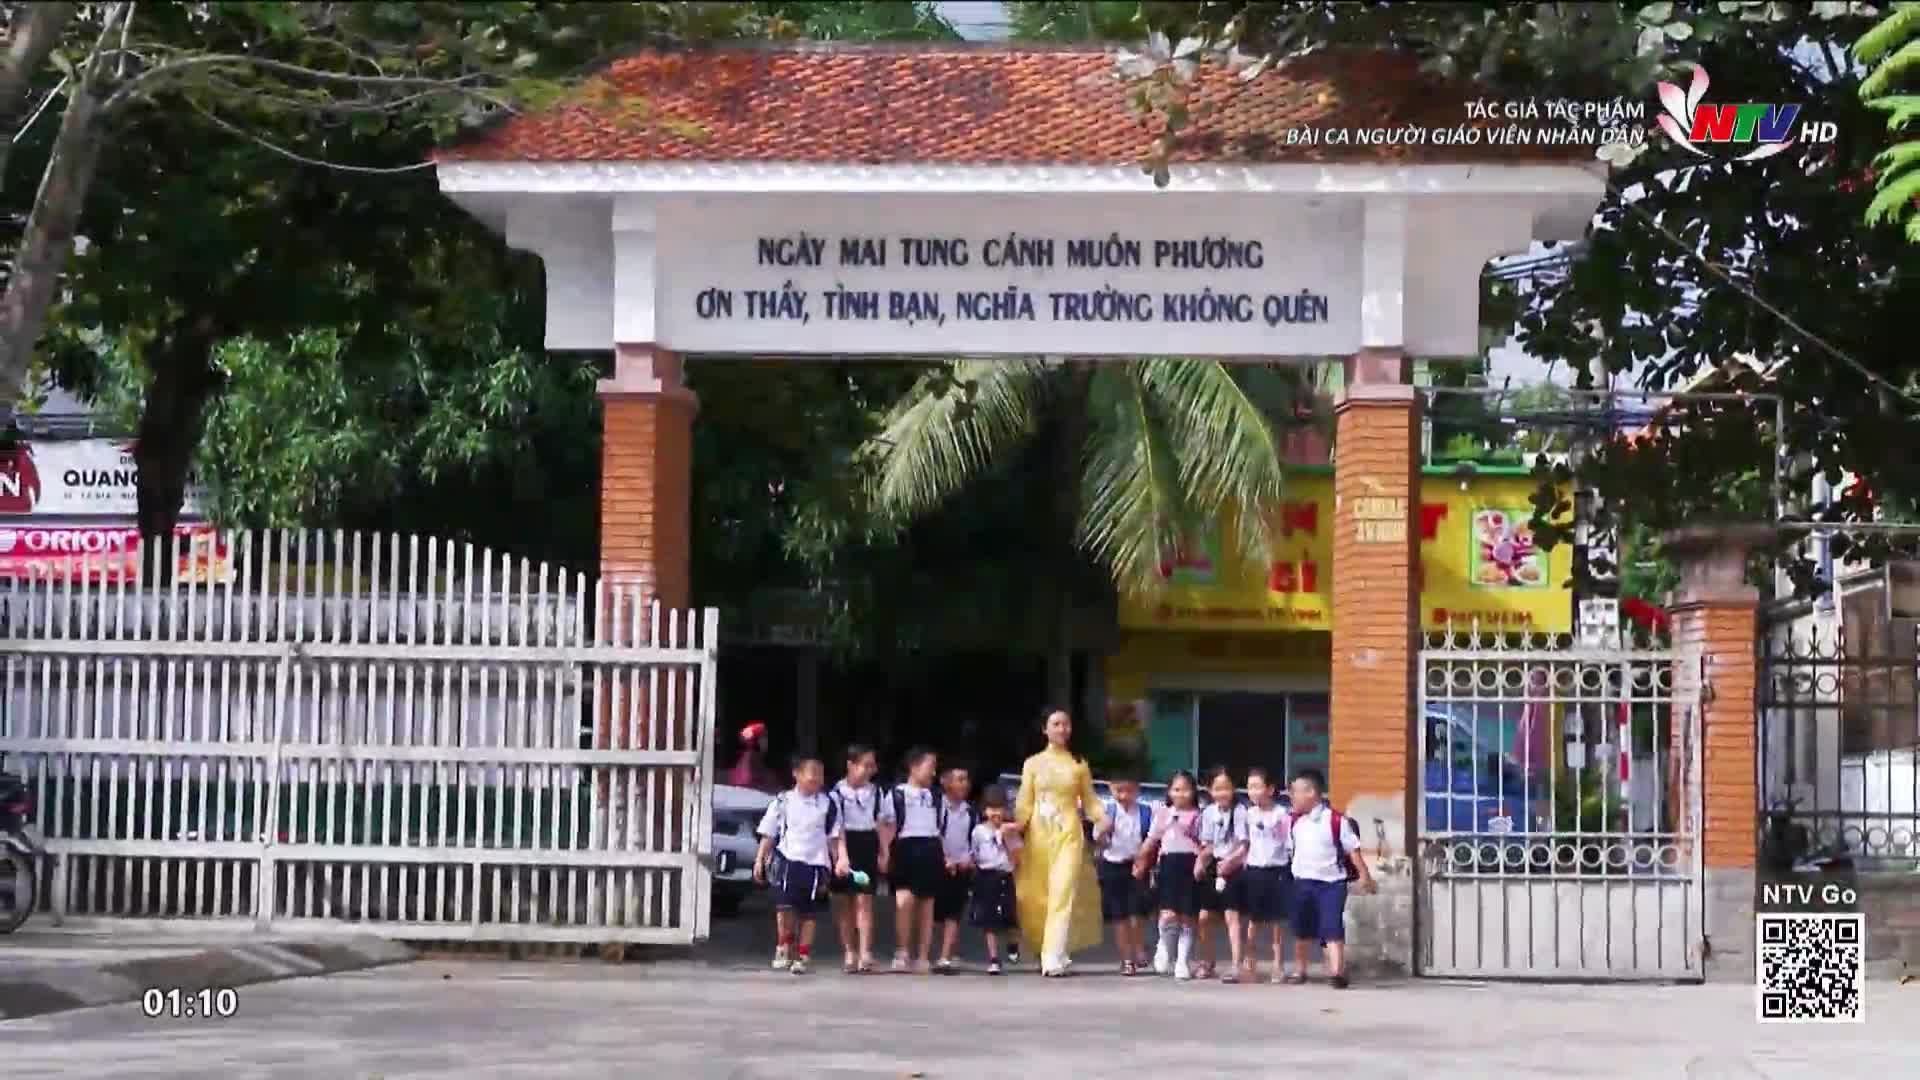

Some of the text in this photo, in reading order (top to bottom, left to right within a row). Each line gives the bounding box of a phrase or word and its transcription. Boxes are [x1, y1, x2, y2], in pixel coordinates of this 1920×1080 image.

[757, 231, 1264, 269] NGÀY MAI TUNG CÁNH MUÔN PHƯƠNG
[696, 287, 733, 319] ƠN
[823, 283, 880, 320] TÌNH
[888, 291, 946, 327] BẠN,
[956, 285, 1036, 321] NGHĨA
[1049, 284, 1152, 322] TRƯỜNG
[1163, 287, 1253, 323] KHÔNG
[1262, 288, 1329, 327] QUÊN
[24, 530, 129, 551] ORION
